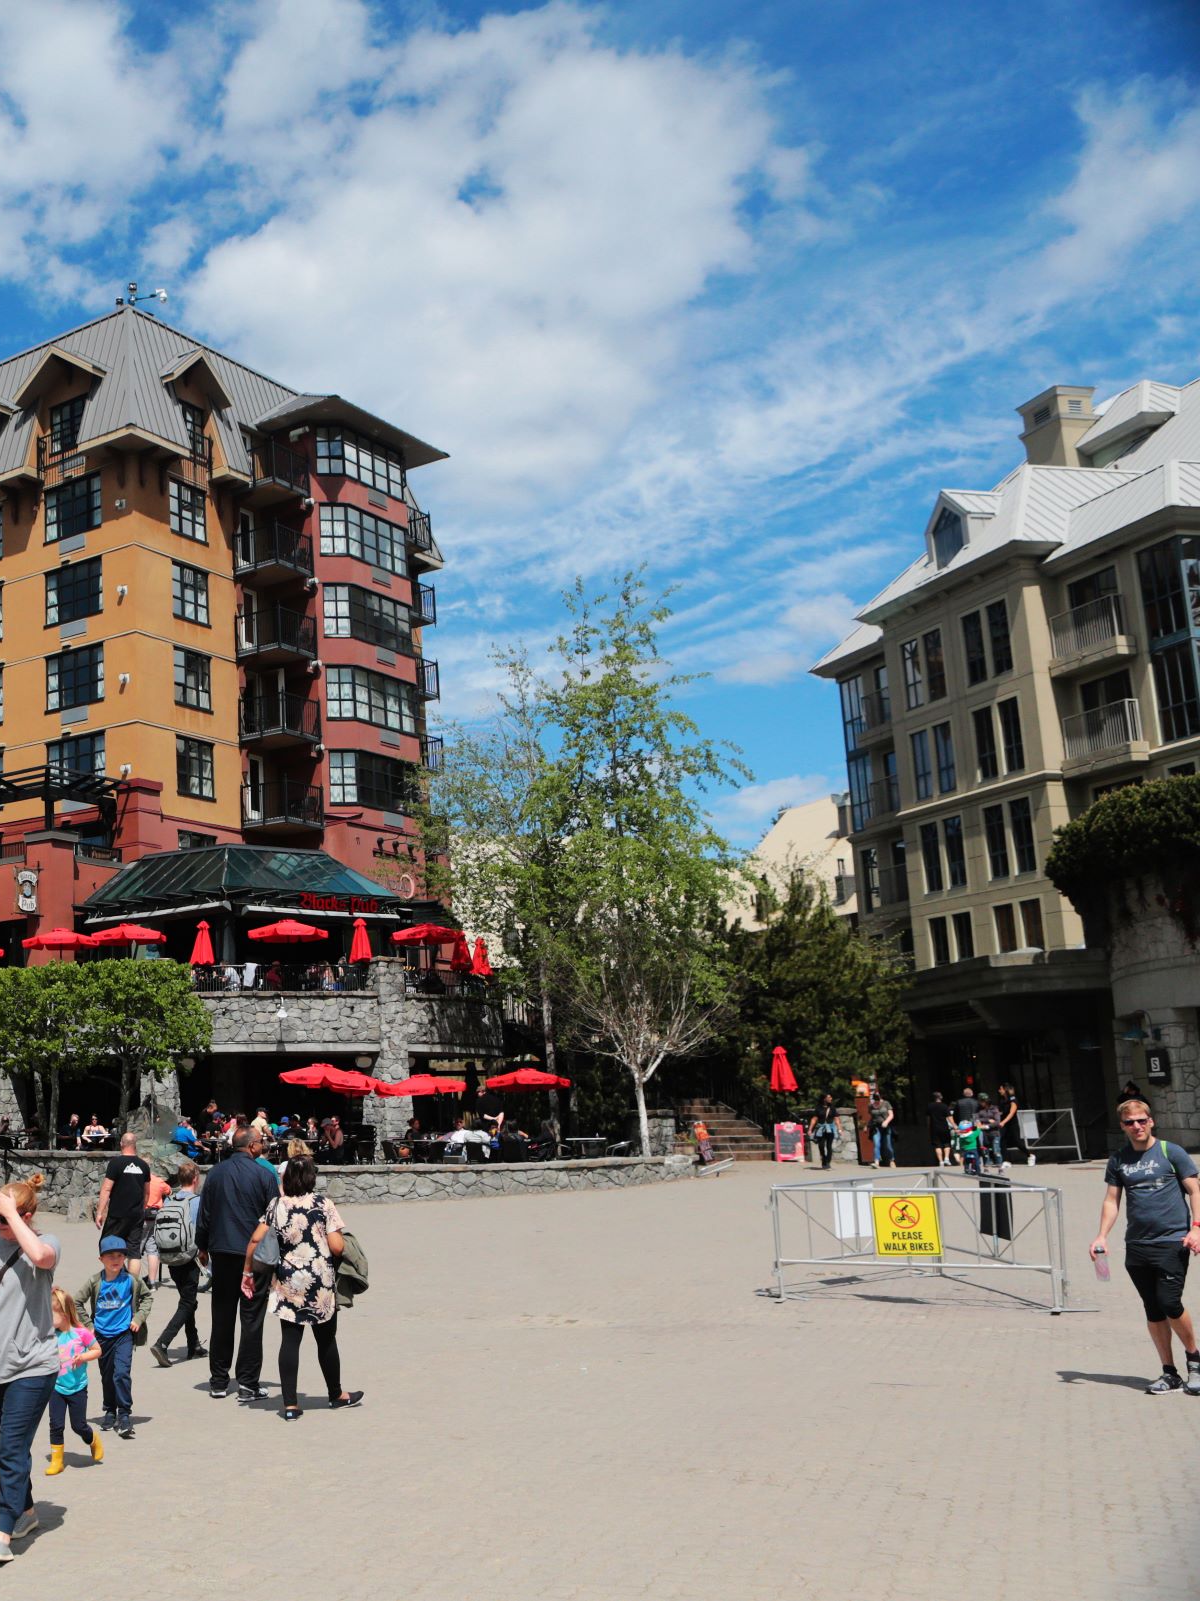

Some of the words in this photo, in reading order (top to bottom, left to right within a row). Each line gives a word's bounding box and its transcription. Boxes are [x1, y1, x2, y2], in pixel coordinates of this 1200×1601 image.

[21, 898, 35, 910] Pub
[299, 891, 347, 912] Blacks
[349, 896, 378, 914] Pub
[891, 1231, 923, 1240] PLEASE
[883, 1242, 908, 1251] WALK
[909, 1242, 935, 1251] BIKES
